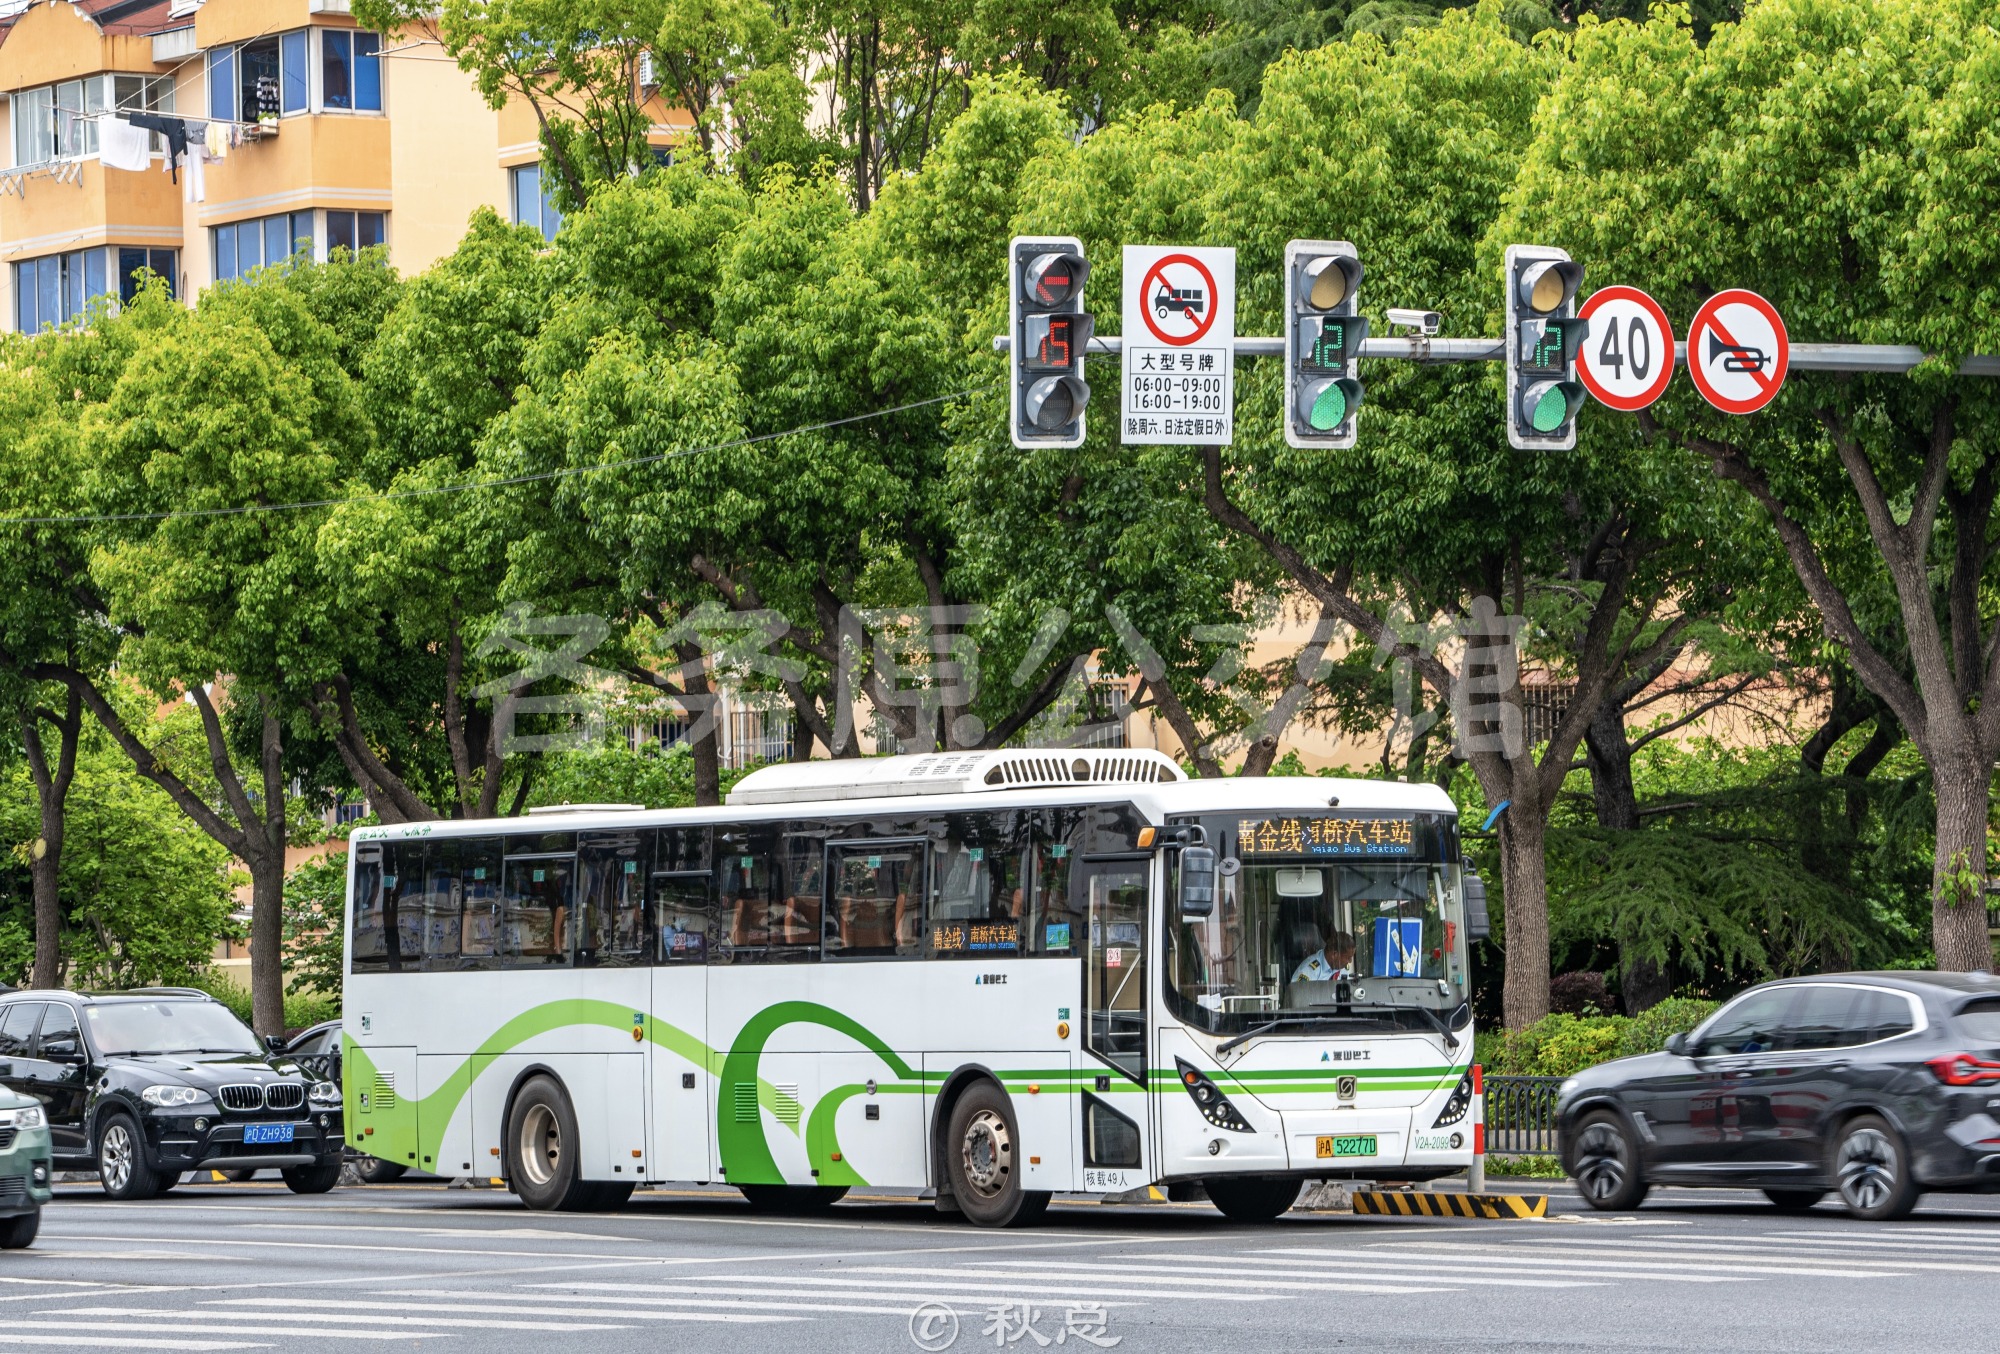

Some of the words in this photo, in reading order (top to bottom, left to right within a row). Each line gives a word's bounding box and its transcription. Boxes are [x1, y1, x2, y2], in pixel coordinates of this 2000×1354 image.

[1599, 315, 1651, 381] 40
[1141, 353, 1214, 372] 大型号牌
[1134, 377, 1220, 393] 06:00-09:00
[1134, 393, 1220, 410] 16:00-19:00
[1343, 843, 1362, 853] Bus
[1366, 843, 1408, 853] Station
[970, 925, 1017, 943] 南桥汽车站
[1085, 1170, 1128, 1187] 核载49人
